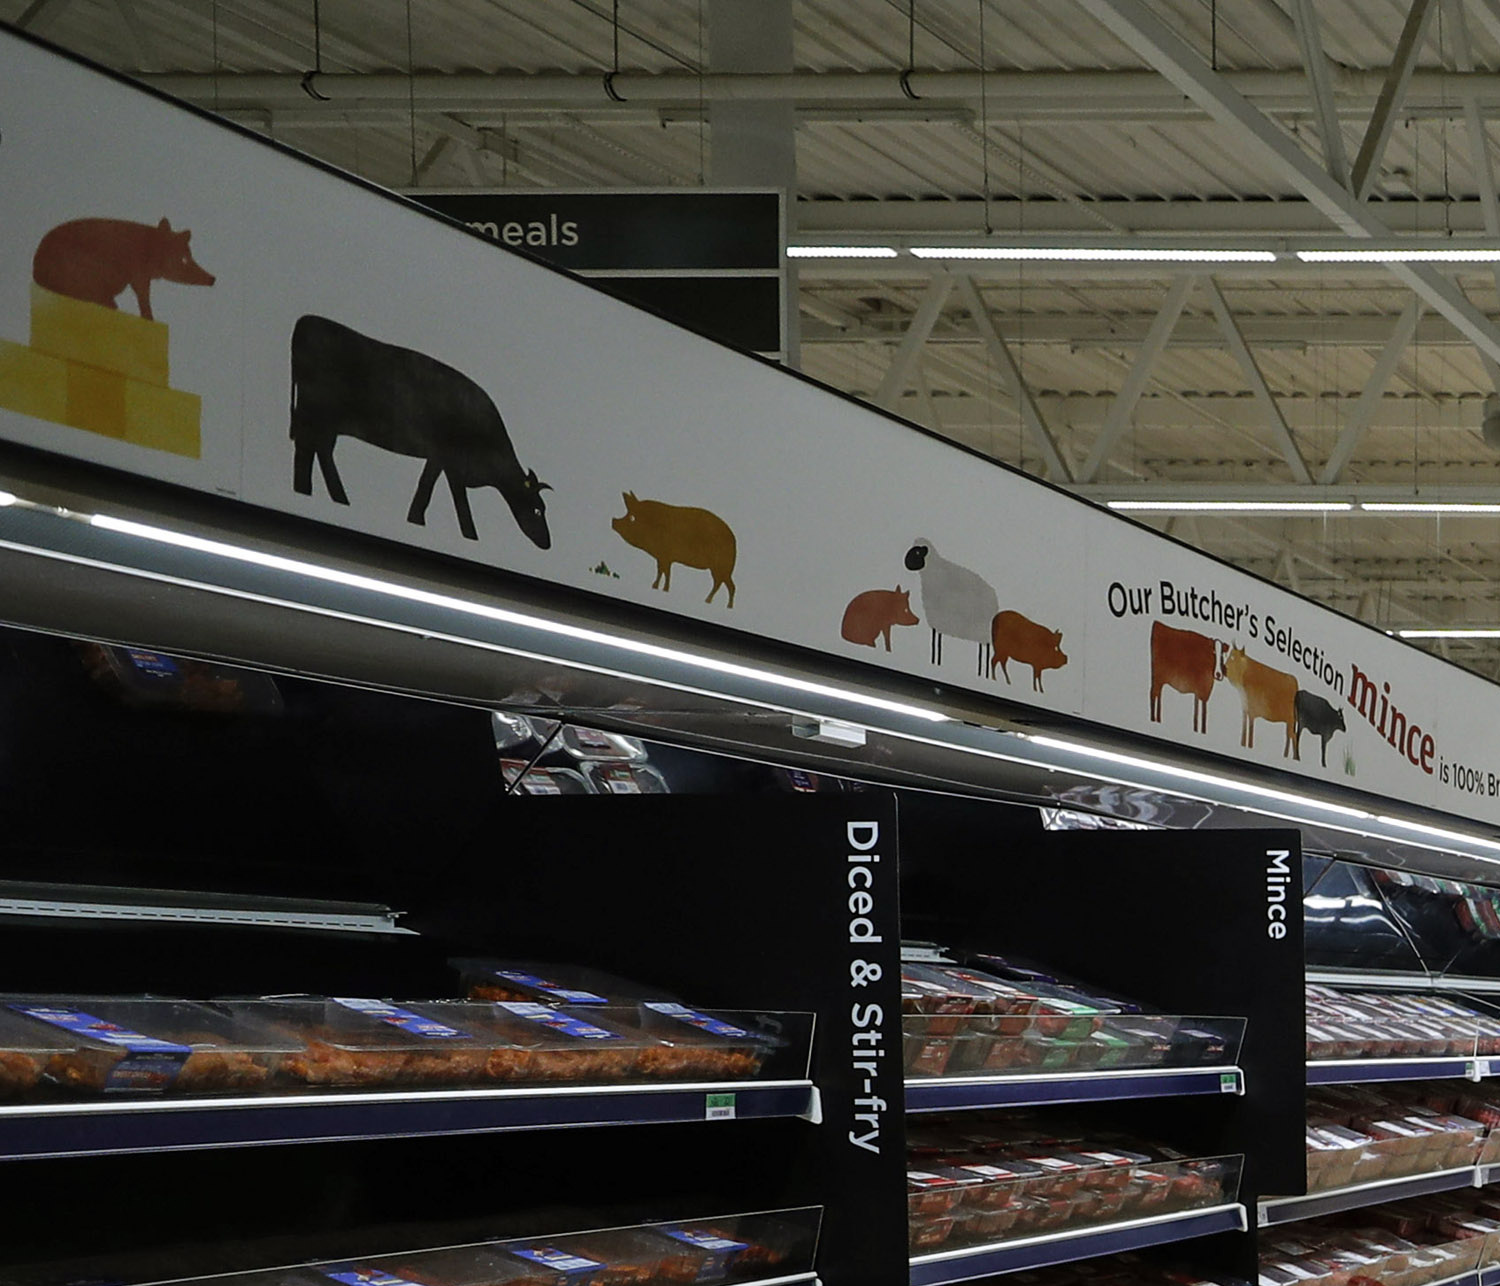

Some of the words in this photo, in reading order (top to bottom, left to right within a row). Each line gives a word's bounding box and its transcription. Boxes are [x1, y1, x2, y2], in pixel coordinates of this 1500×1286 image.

[1107, 581, 1152, 617] Our
[1159, 580, 1258, 638] Butcher's
[1264, 615, 1344, 695] Selection
[1347, 663, 1435, 774] mince
[1440, 757, 1449, 784] is
[1452, 763, 1485, 796] 100%
[846, 820, 882, 944] Diced
[1266, 849, 1291, 940] Mince
[850, 958, 882, 987] &
[849, 1003, 886, 1154] Stir-fry
